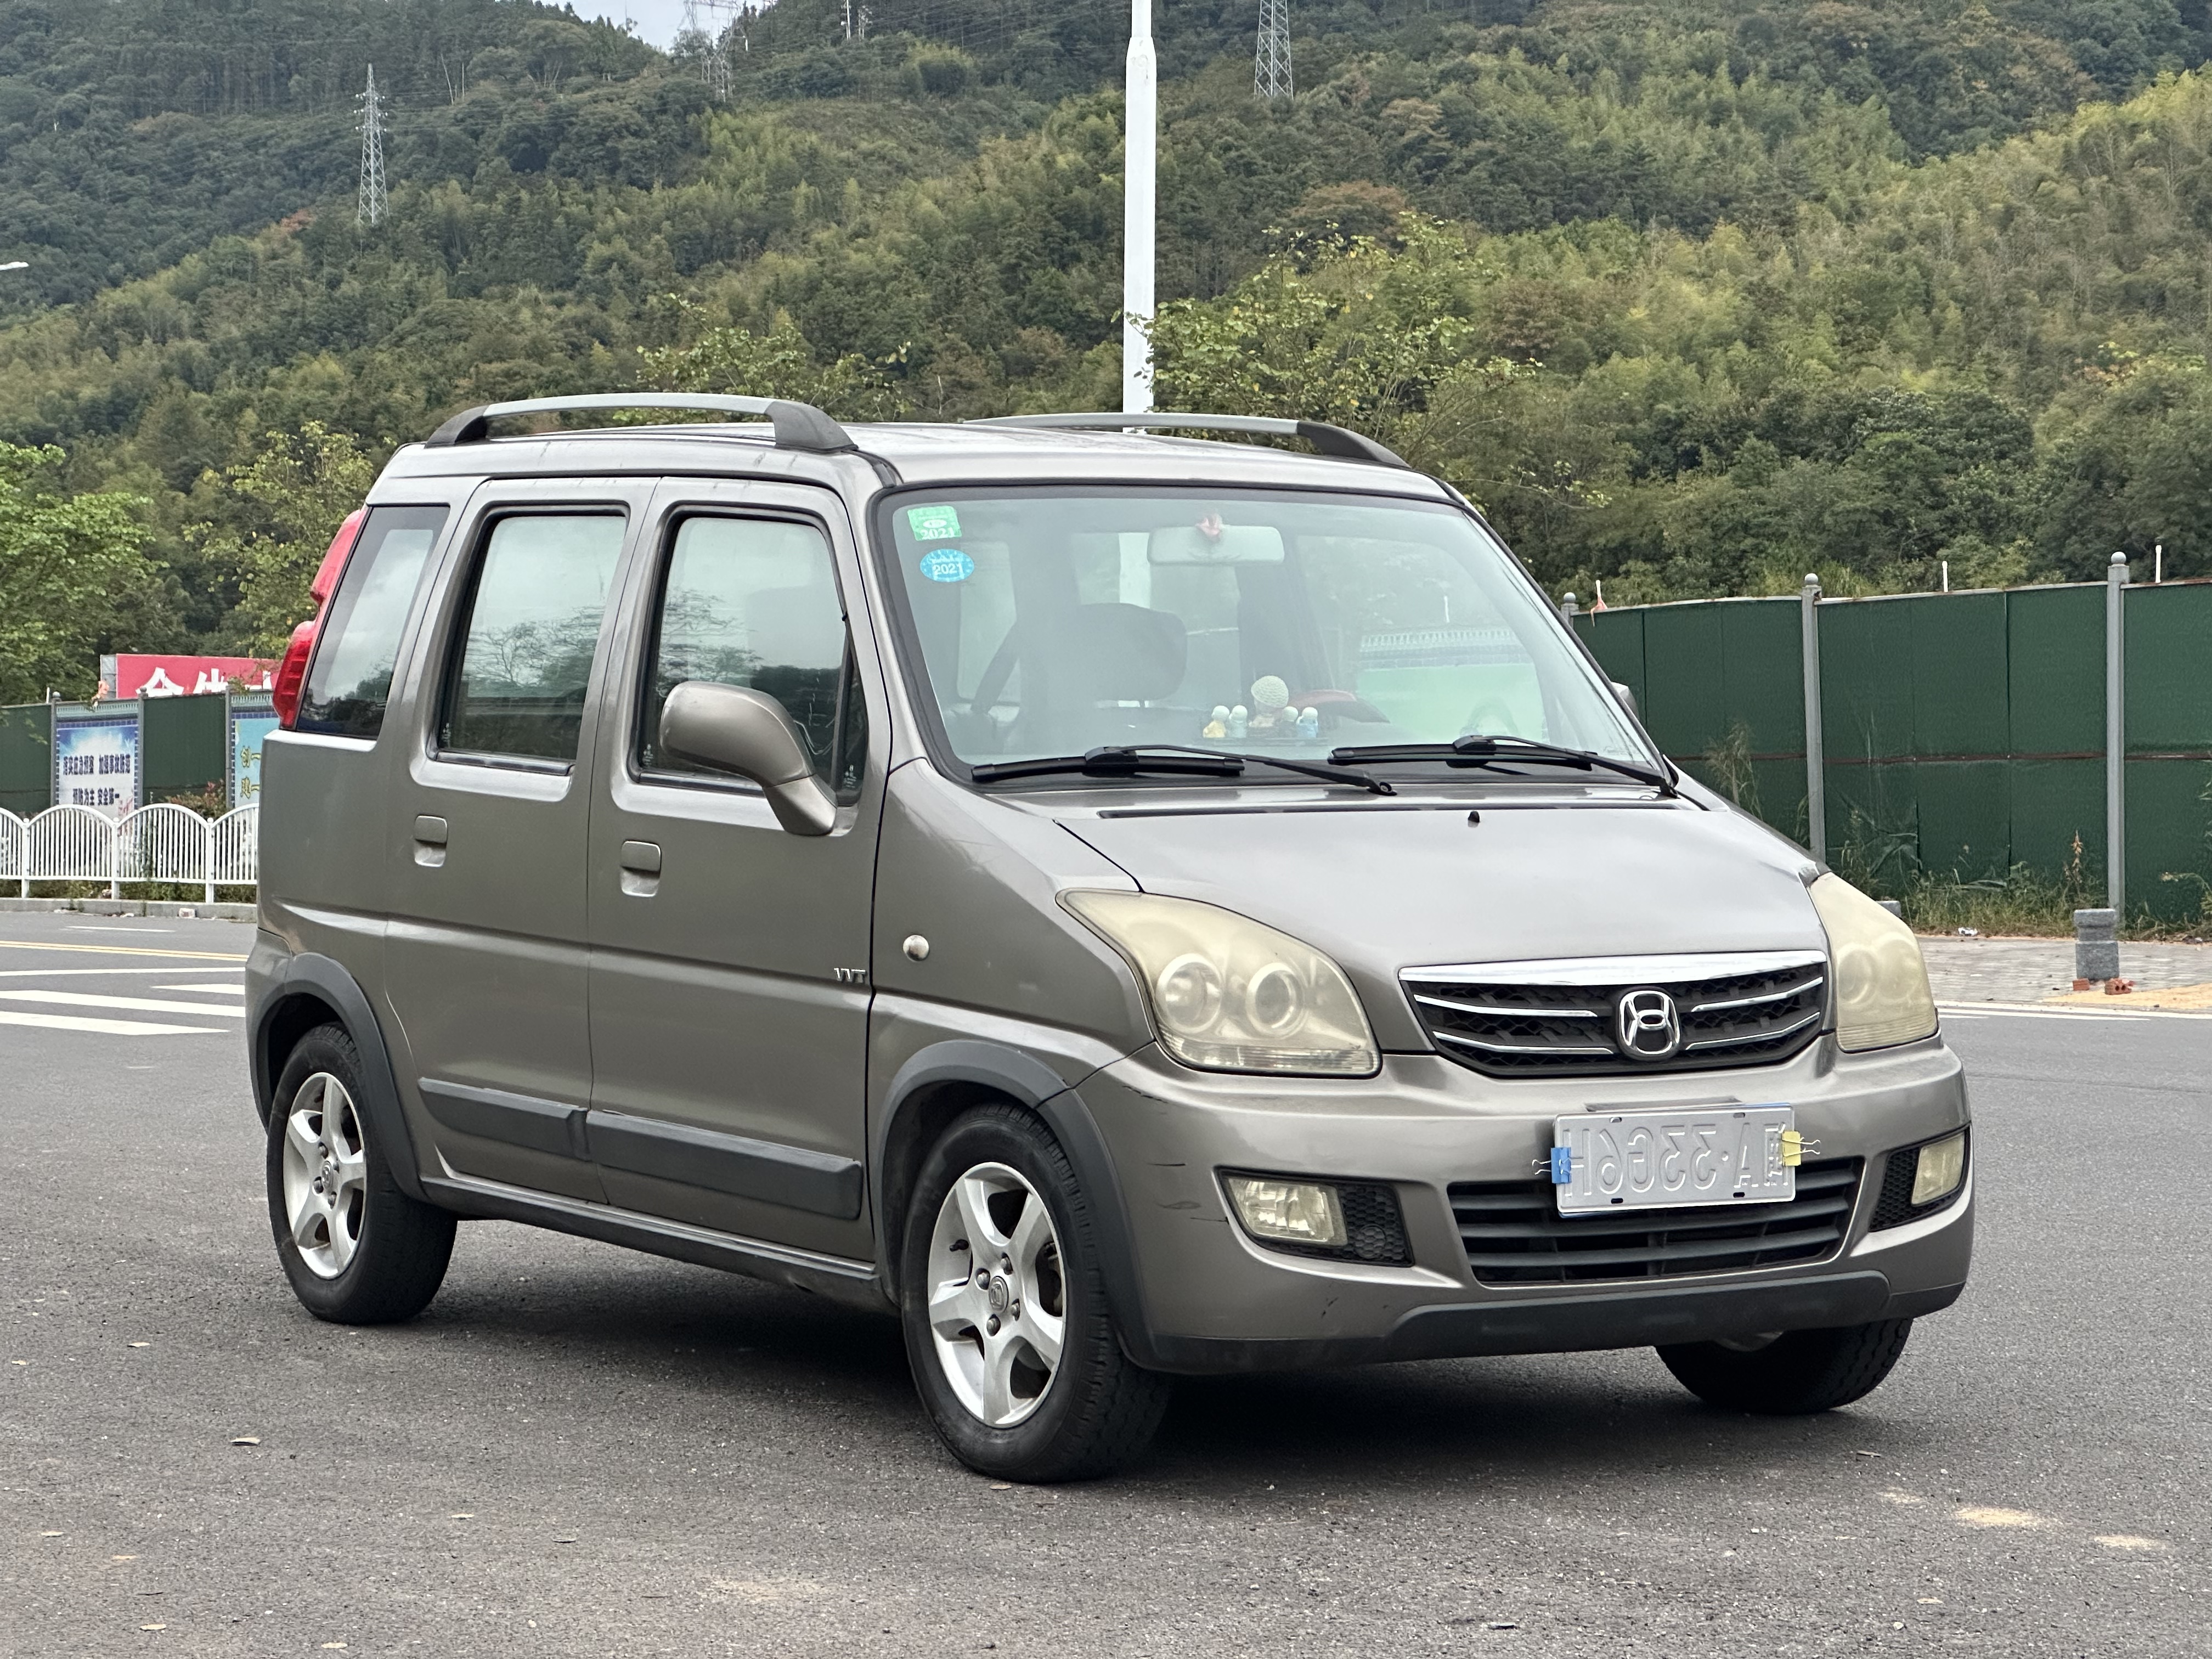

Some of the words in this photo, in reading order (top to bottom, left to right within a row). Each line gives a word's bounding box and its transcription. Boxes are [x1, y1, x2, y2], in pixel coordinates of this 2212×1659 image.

[920, 527, 956, 540] 2021
[932, 562, 964, 575] 2021
[72, 788, 94, 805] 预防为主
[98, 787, 120, 805] 安全第一
[834, 968, 867, 983] VVT
